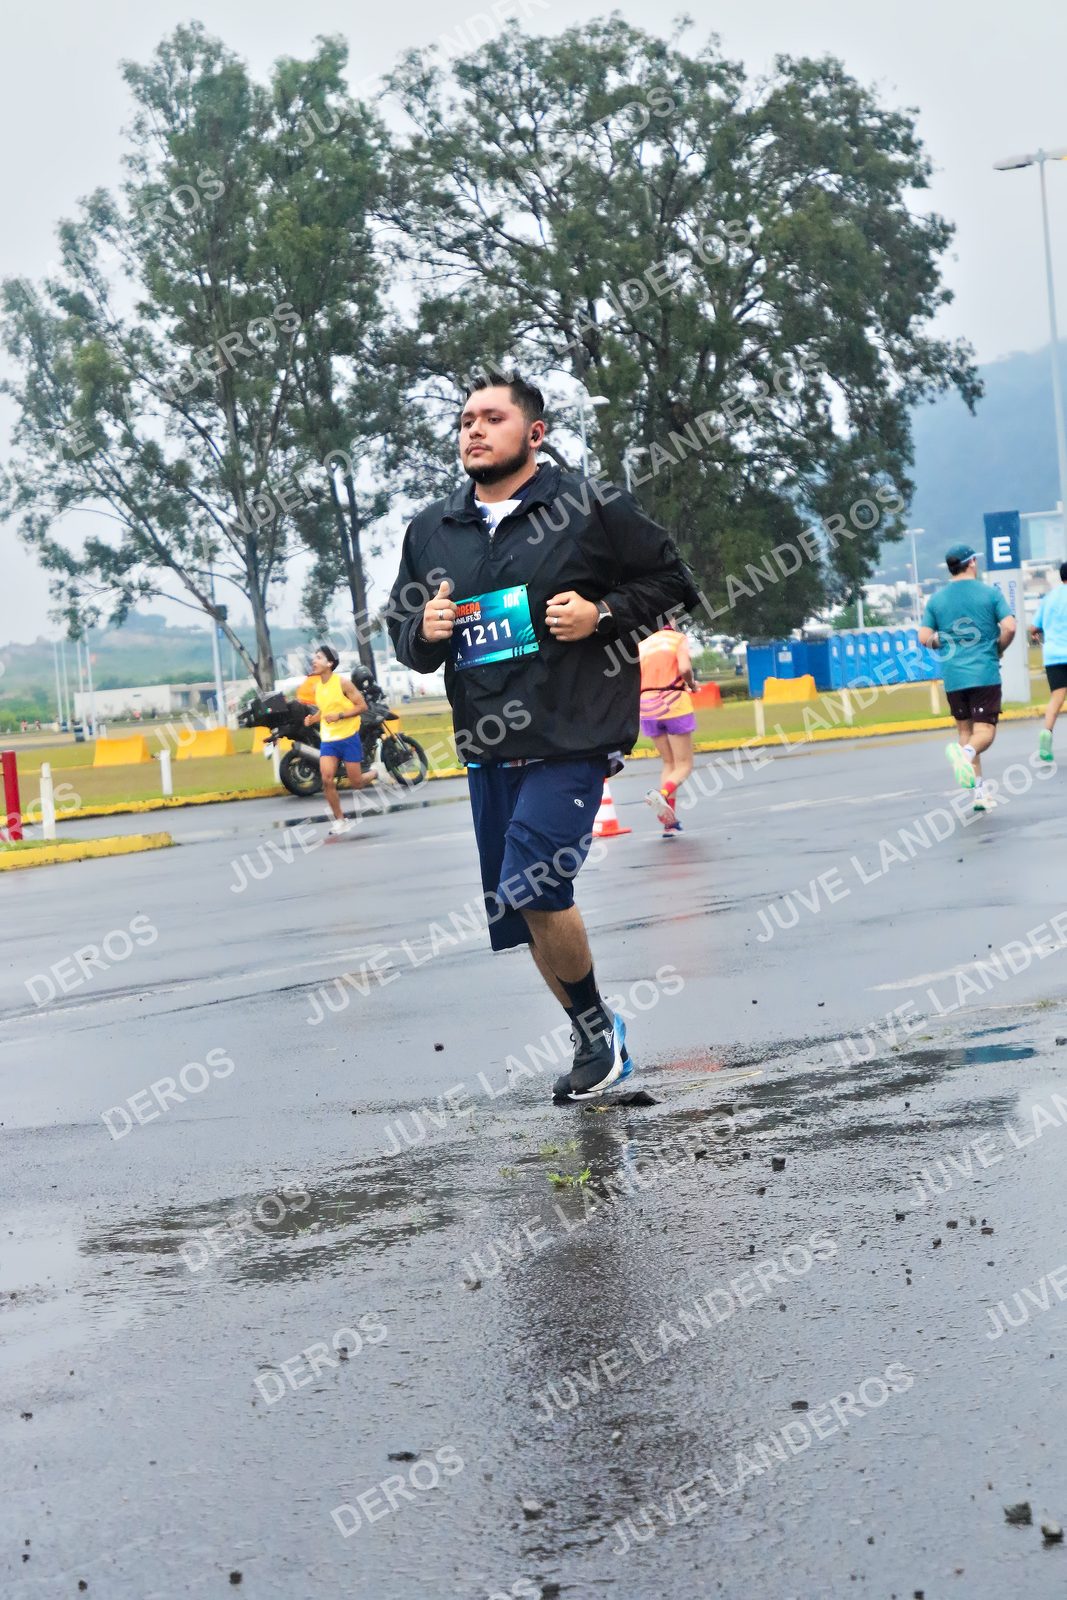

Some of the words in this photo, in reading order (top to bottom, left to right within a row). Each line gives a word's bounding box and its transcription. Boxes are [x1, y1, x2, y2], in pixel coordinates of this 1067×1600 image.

[991, 536, 1012, 563] E
[456, 602, 480, 618] RRERA
[503, 592, 520, 609] 10K
[462, 618, 512, 647] 1211
